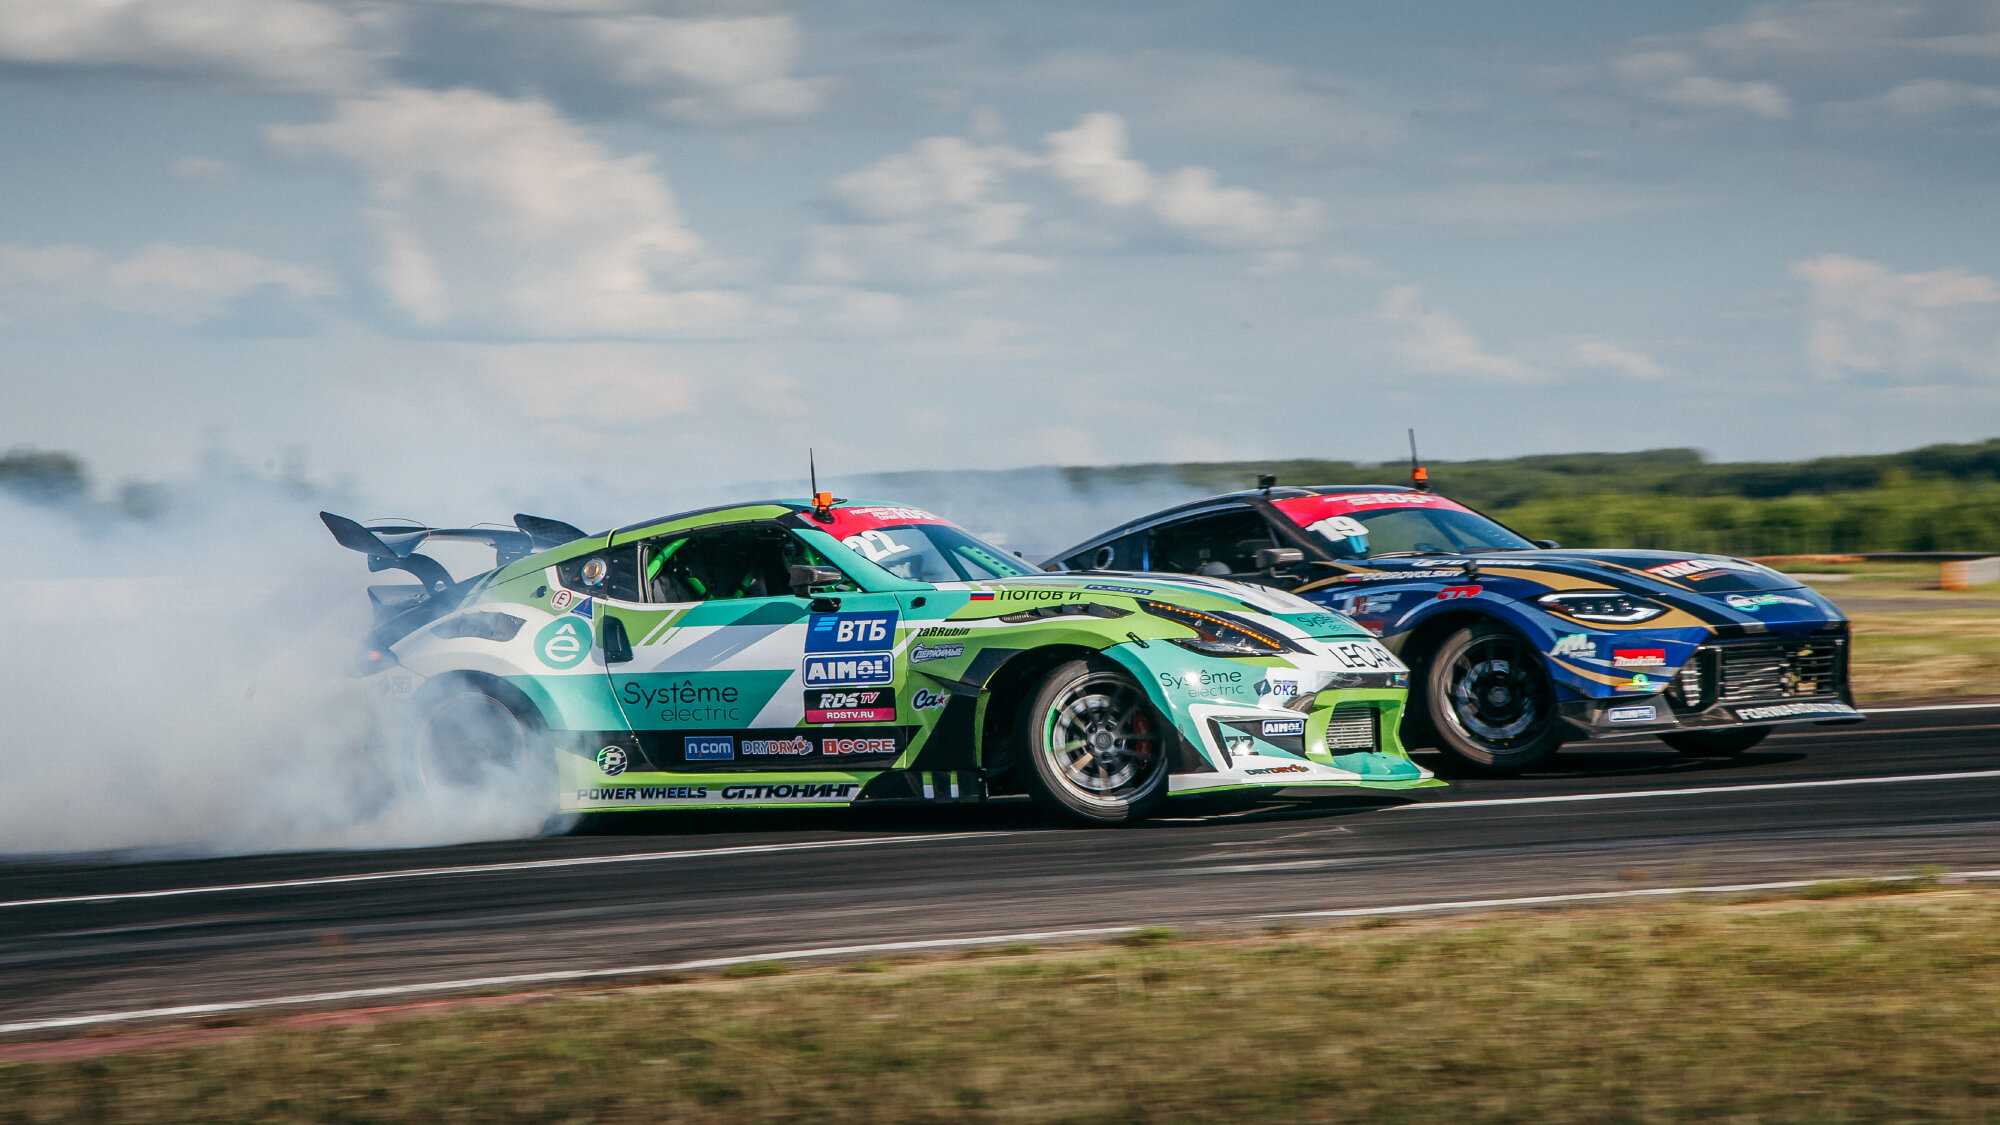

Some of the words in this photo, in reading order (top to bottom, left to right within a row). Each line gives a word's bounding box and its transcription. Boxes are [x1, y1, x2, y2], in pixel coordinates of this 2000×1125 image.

[1305, 516, 1369, 541] 19
[842, 530, 911, 562] 22
[1000, 591, 1064, 600] ПОПОВ
[837, 619, 887, 642] ВТБ
[807, 660, 889, 680] AIMOL
[623, 680, 738, 709] Systême
[1188, 684, 1245, 698] electric
[819, 693, 860, 709] RDS
[661, 704, 740, 721] electric
[826, 711, 875, 719] RDSTV.RU
[577, 788, 637, 800] POWER
[640, 786, 708, 799] WHEELS
